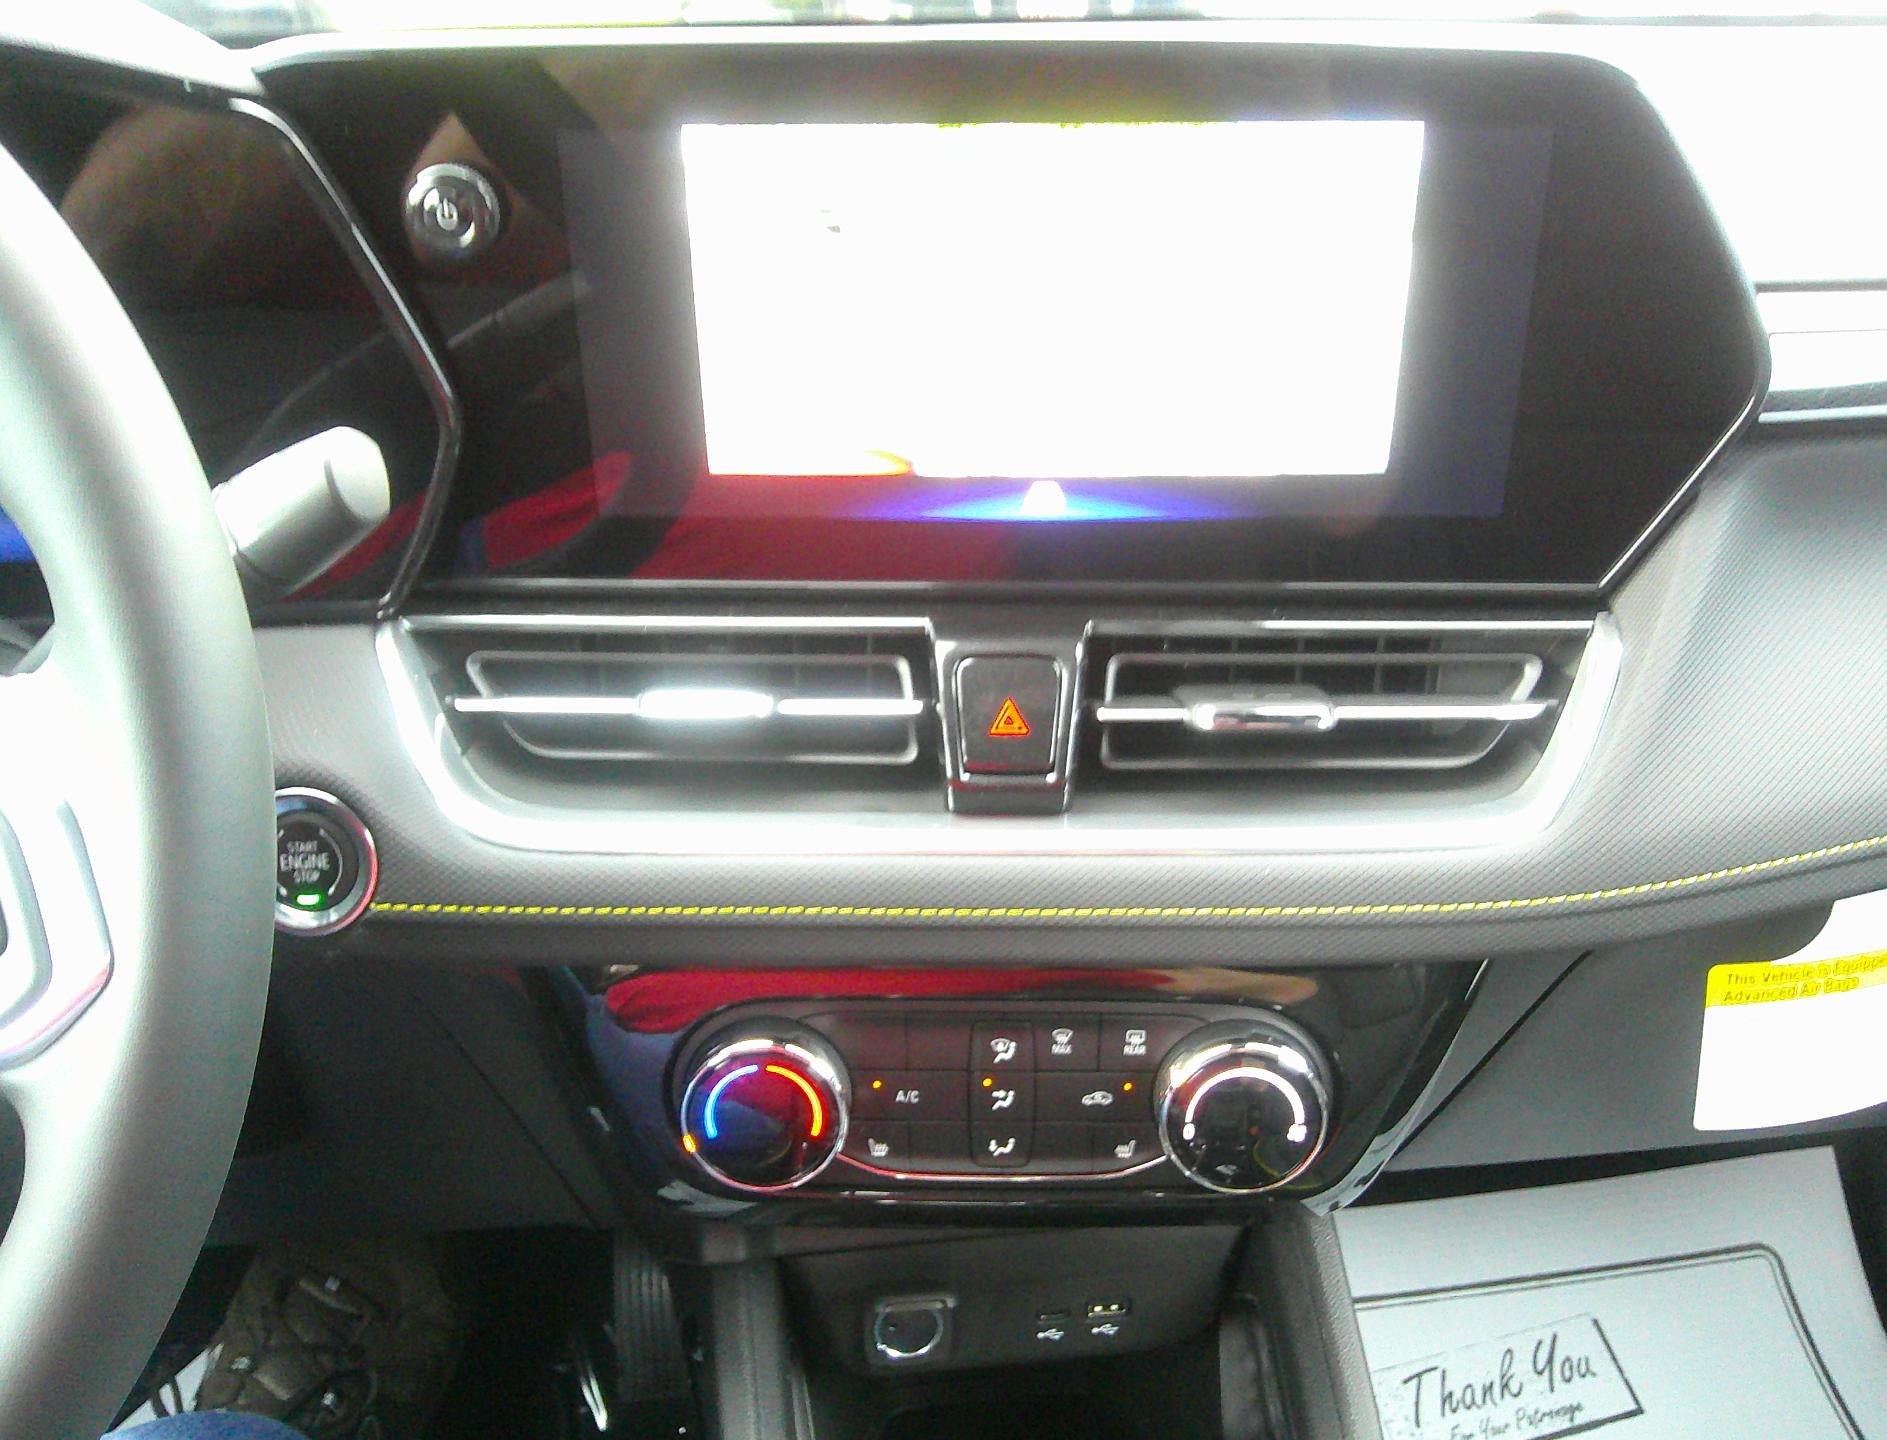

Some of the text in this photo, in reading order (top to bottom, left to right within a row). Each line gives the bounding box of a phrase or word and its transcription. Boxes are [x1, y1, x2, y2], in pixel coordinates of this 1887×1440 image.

[279, 852, 330, 872] ENGINE
[1727, 972, 1756, 985] This
[1762, 967, 1815, 983] Vehicle
[1724, 984, 1798, 1002] Advanced
[895, 1090, 919, 1104] A/C
[1402, 1331, 1597, 1429] Thank You
